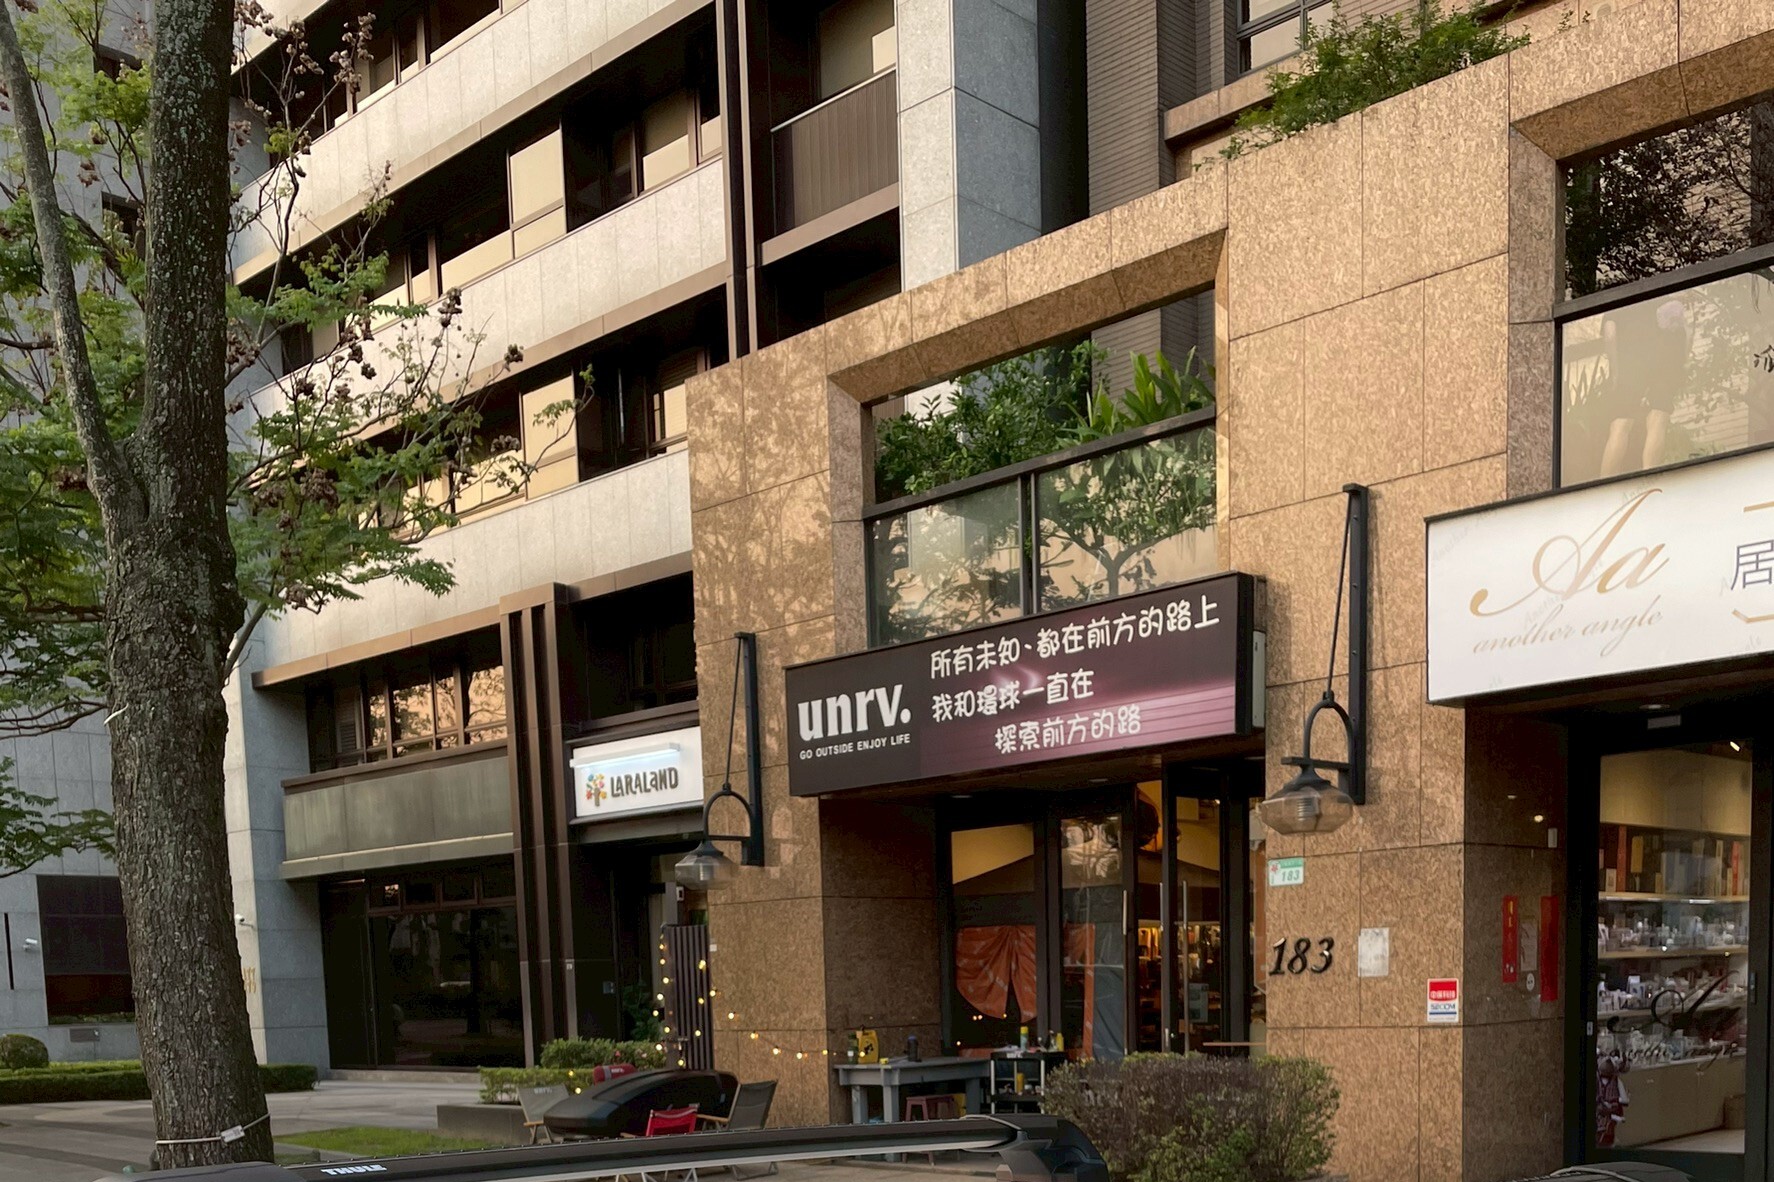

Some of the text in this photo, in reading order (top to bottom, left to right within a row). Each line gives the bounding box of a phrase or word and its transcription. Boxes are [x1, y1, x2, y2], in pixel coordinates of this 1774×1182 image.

[1469, 488, 1669, 616] Aa
[1472, 603, 1576, 654] another
[1582, 594, 1664, 657] angle
[797, 684, 912, 742] unrv.
[931, 668, 1095, 723] 我和環球一直在
[799, 733, 911, 761] GO OUTSIDE ENJOY LIFE
[994, 703, 1142, 755] 探索前方的路
[1281, 869, 1300, 882] 183
[1269, 937, 1335, 976] 183
[321, 1164, 387, 1176] THULE
